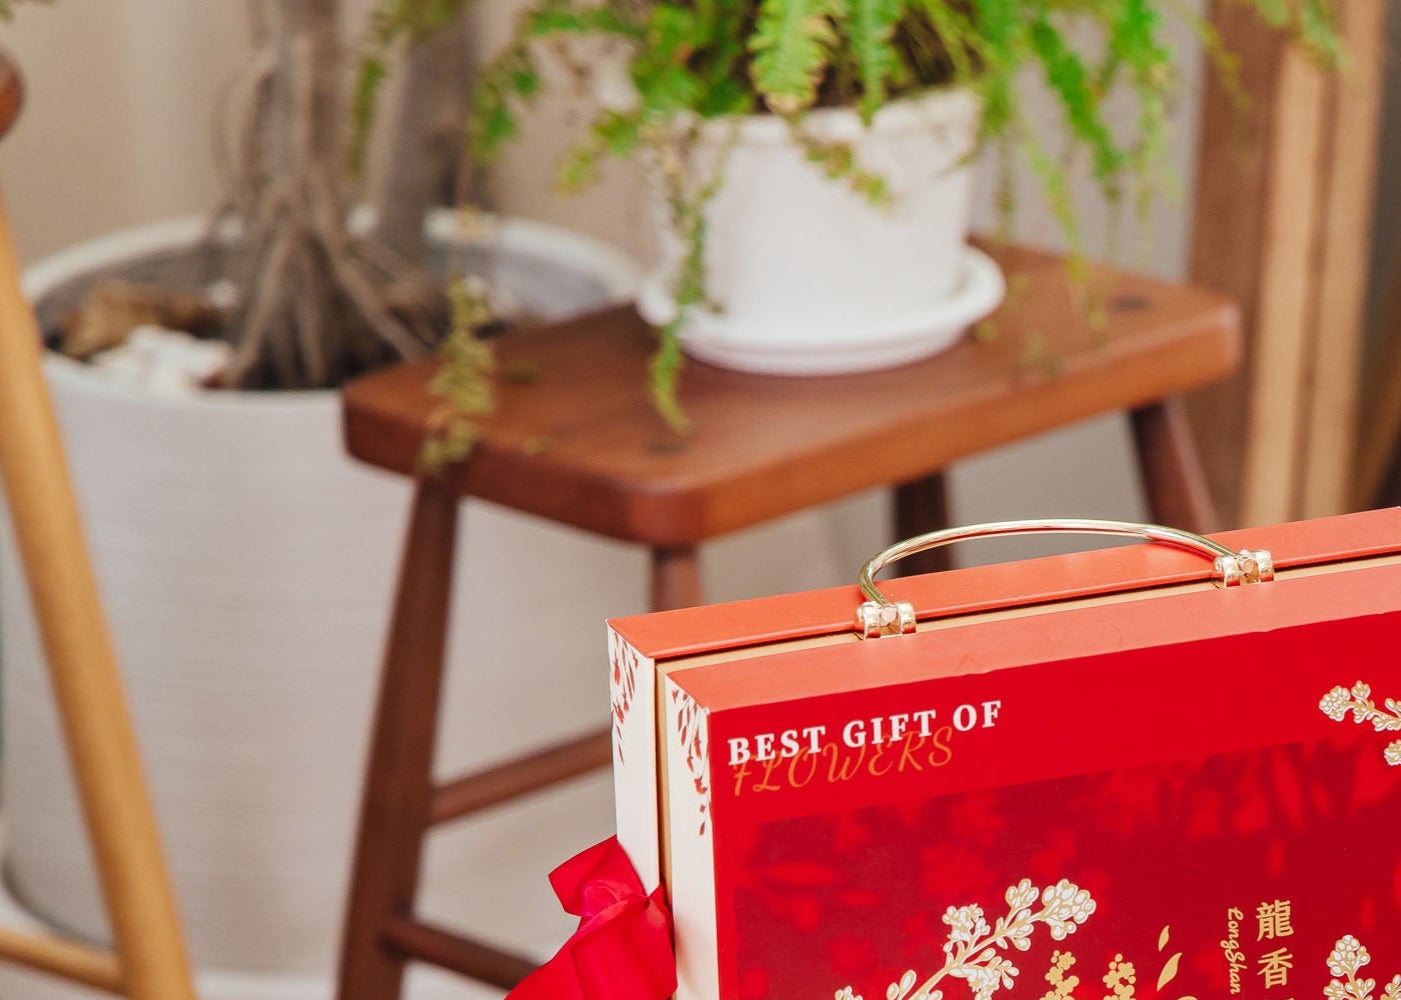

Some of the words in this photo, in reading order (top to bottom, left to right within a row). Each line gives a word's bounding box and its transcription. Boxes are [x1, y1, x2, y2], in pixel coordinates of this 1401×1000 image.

[728, 725, 826, 766] BEST
[843, 710, 936, 748] GIFT
[953, 700, 1001, 732] OF
[732, 726, 953, 796] FLOWERS
[1220, 906, 1248, 995] LongShan
